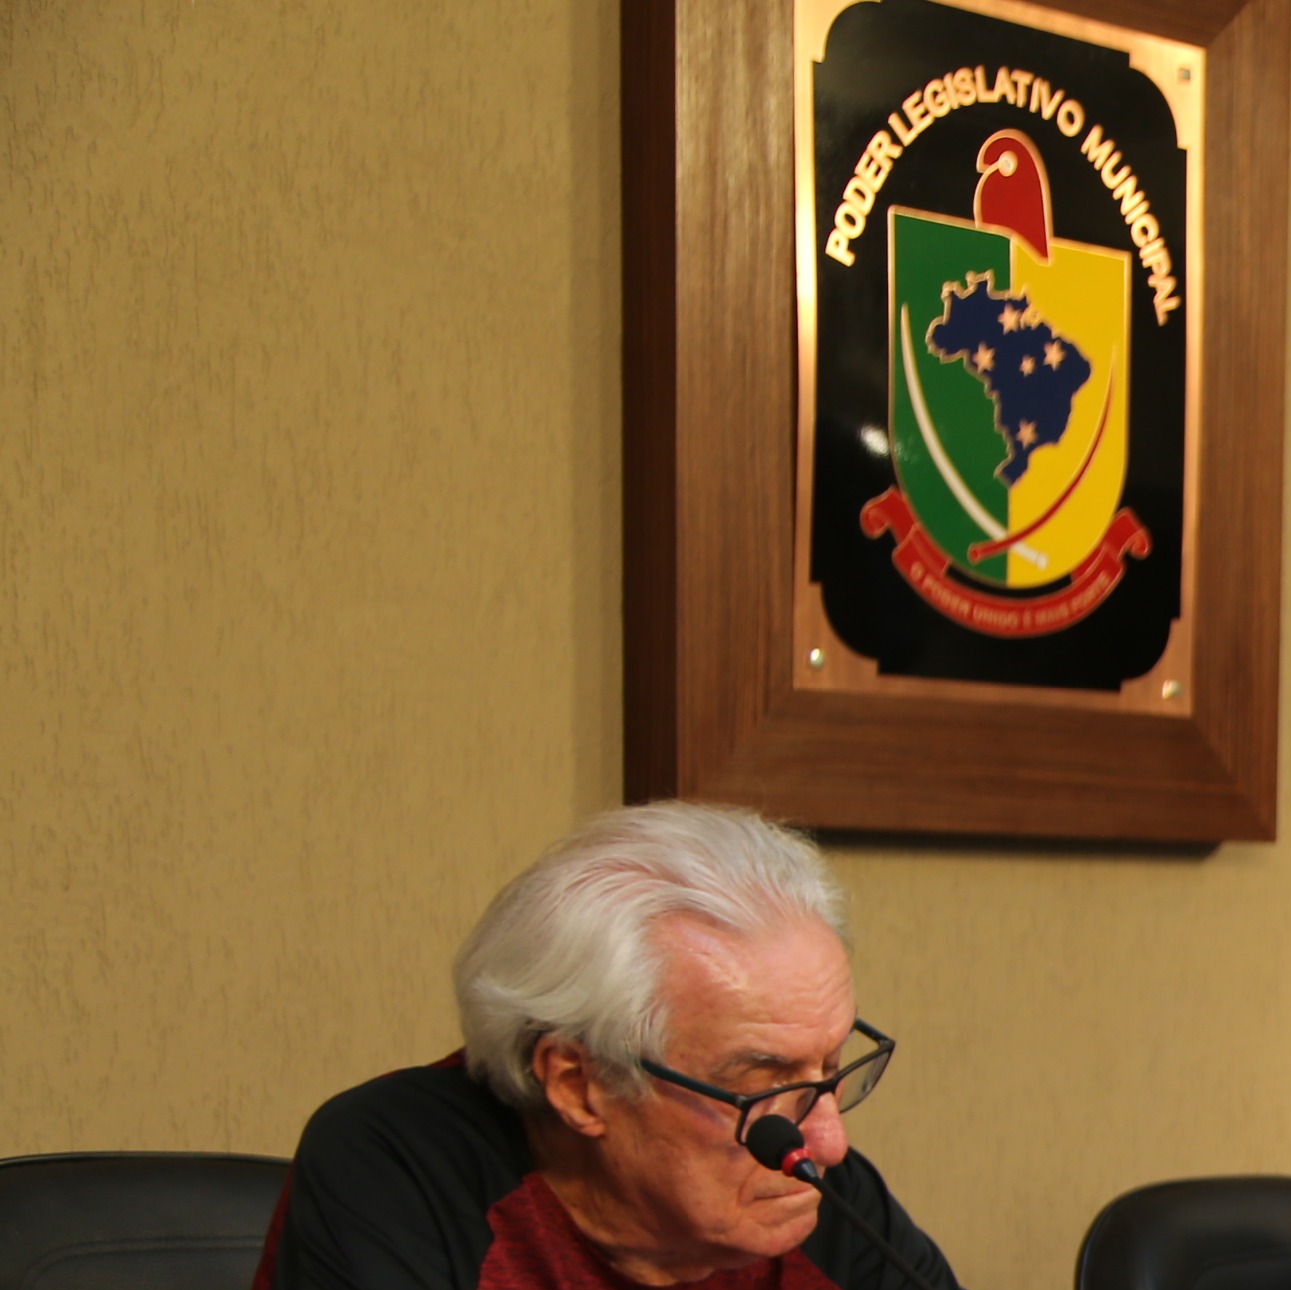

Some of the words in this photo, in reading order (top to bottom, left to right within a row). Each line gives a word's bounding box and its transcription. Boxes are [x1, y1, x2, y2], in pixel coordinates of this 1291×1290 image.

[825, 130, 903, 267] PODER
[887, 64, 1086, 147] LEGISLATIVO
[1080, 124, 1181, 328] MUNICIPAL
